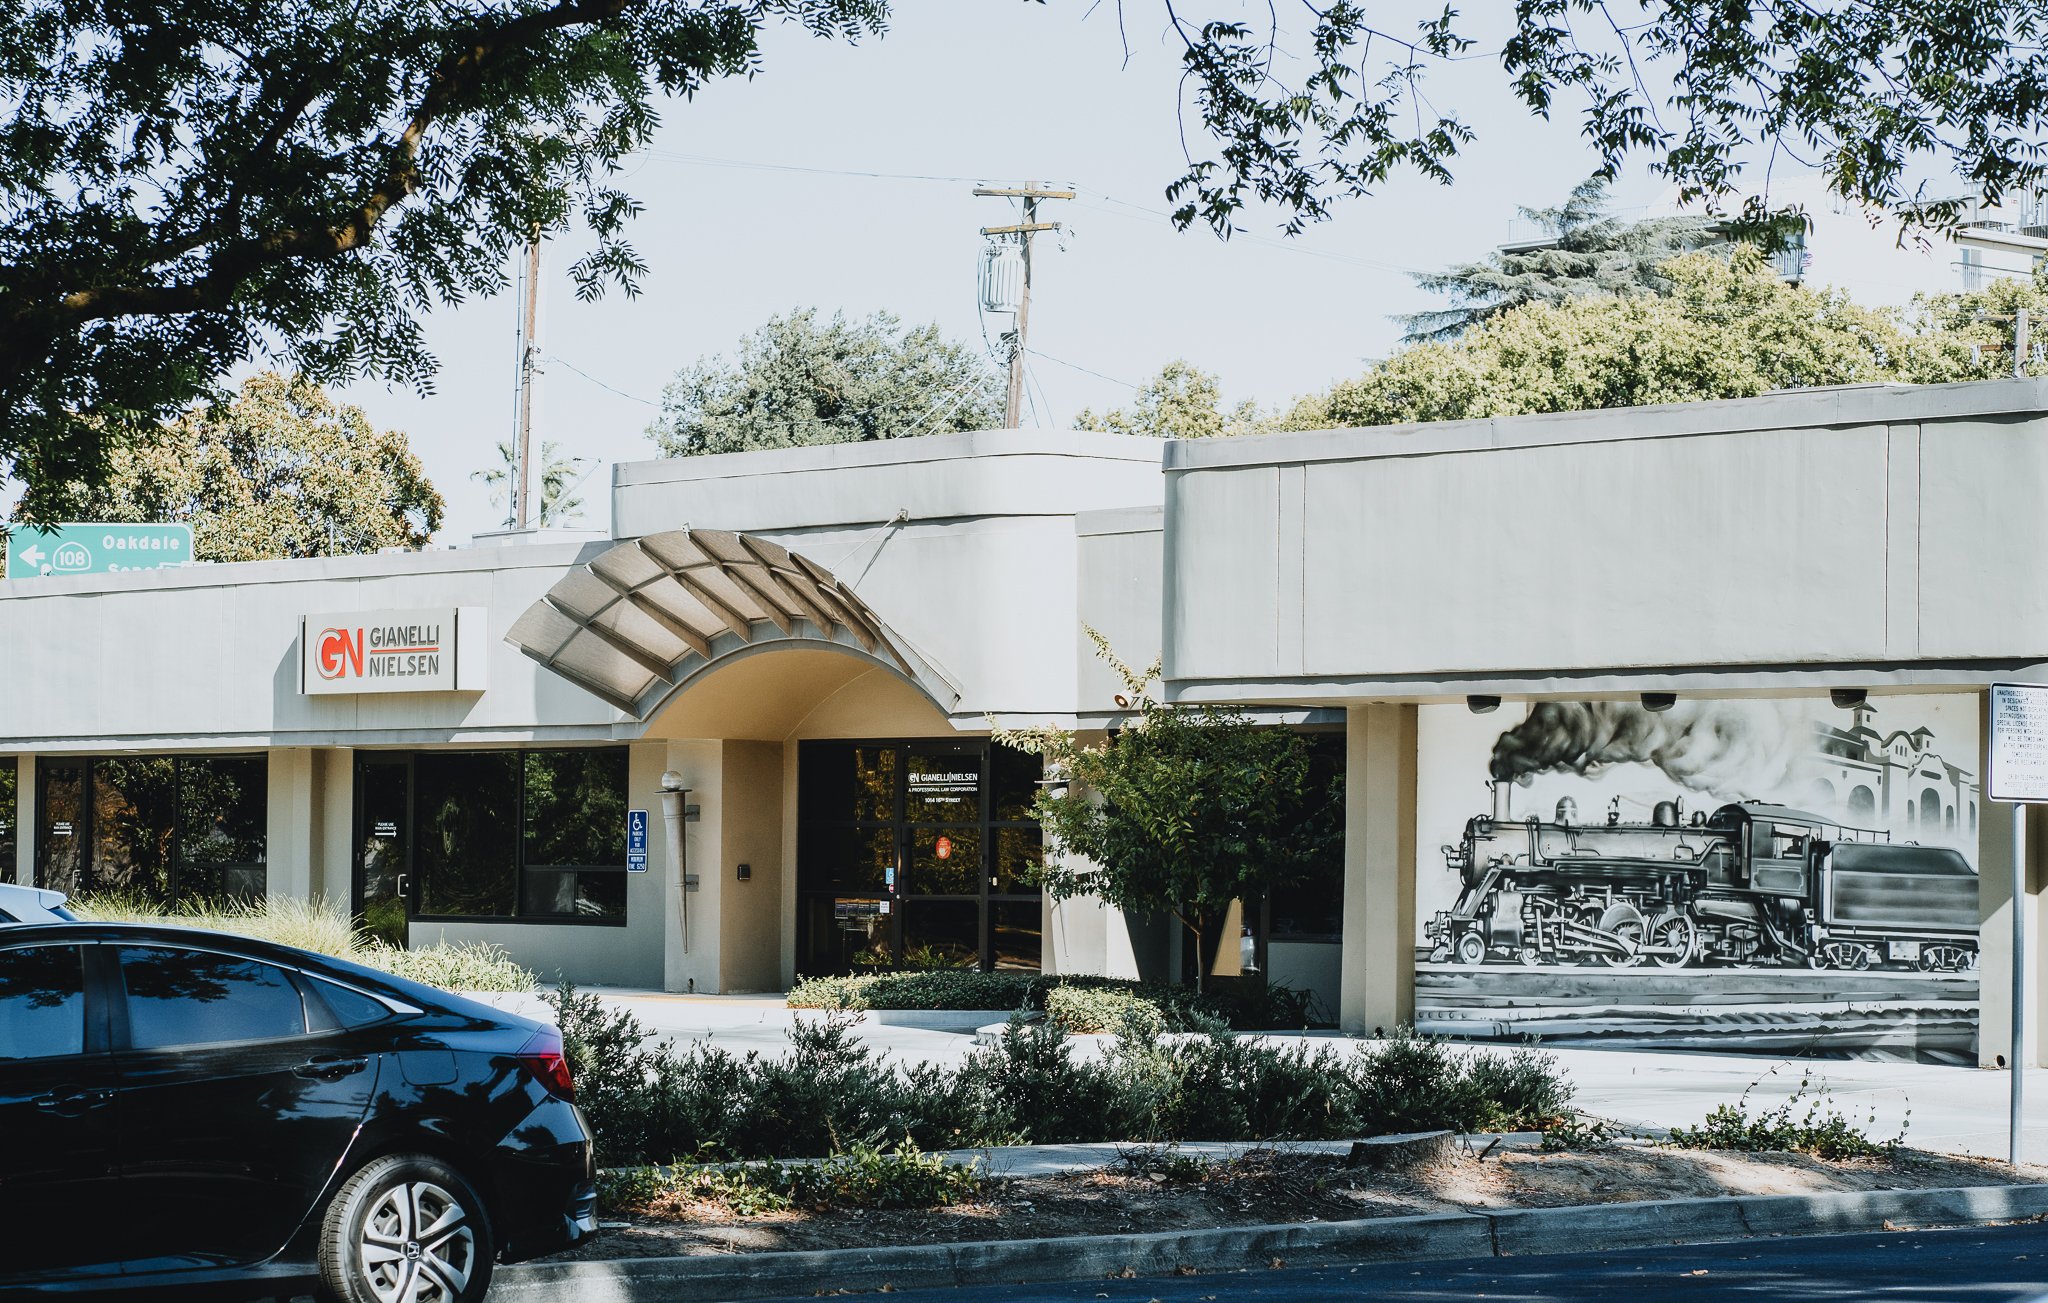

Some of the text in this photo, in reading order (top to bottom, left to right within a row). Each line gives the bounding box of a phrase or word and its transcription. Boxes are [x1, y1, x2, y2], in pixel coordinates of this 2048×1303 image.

[102, 534, 180, 550] Oakdale
[59, 551, 85, 566] 108
[370, 624, 440, 648] GIANELLI
[315, 627, 363, 680] GN
[369, 654, 439, 677] NIELSEN
[920, 773, 949, 782] GIANELLI
[951, 772, 978, 782] NIELSEN
